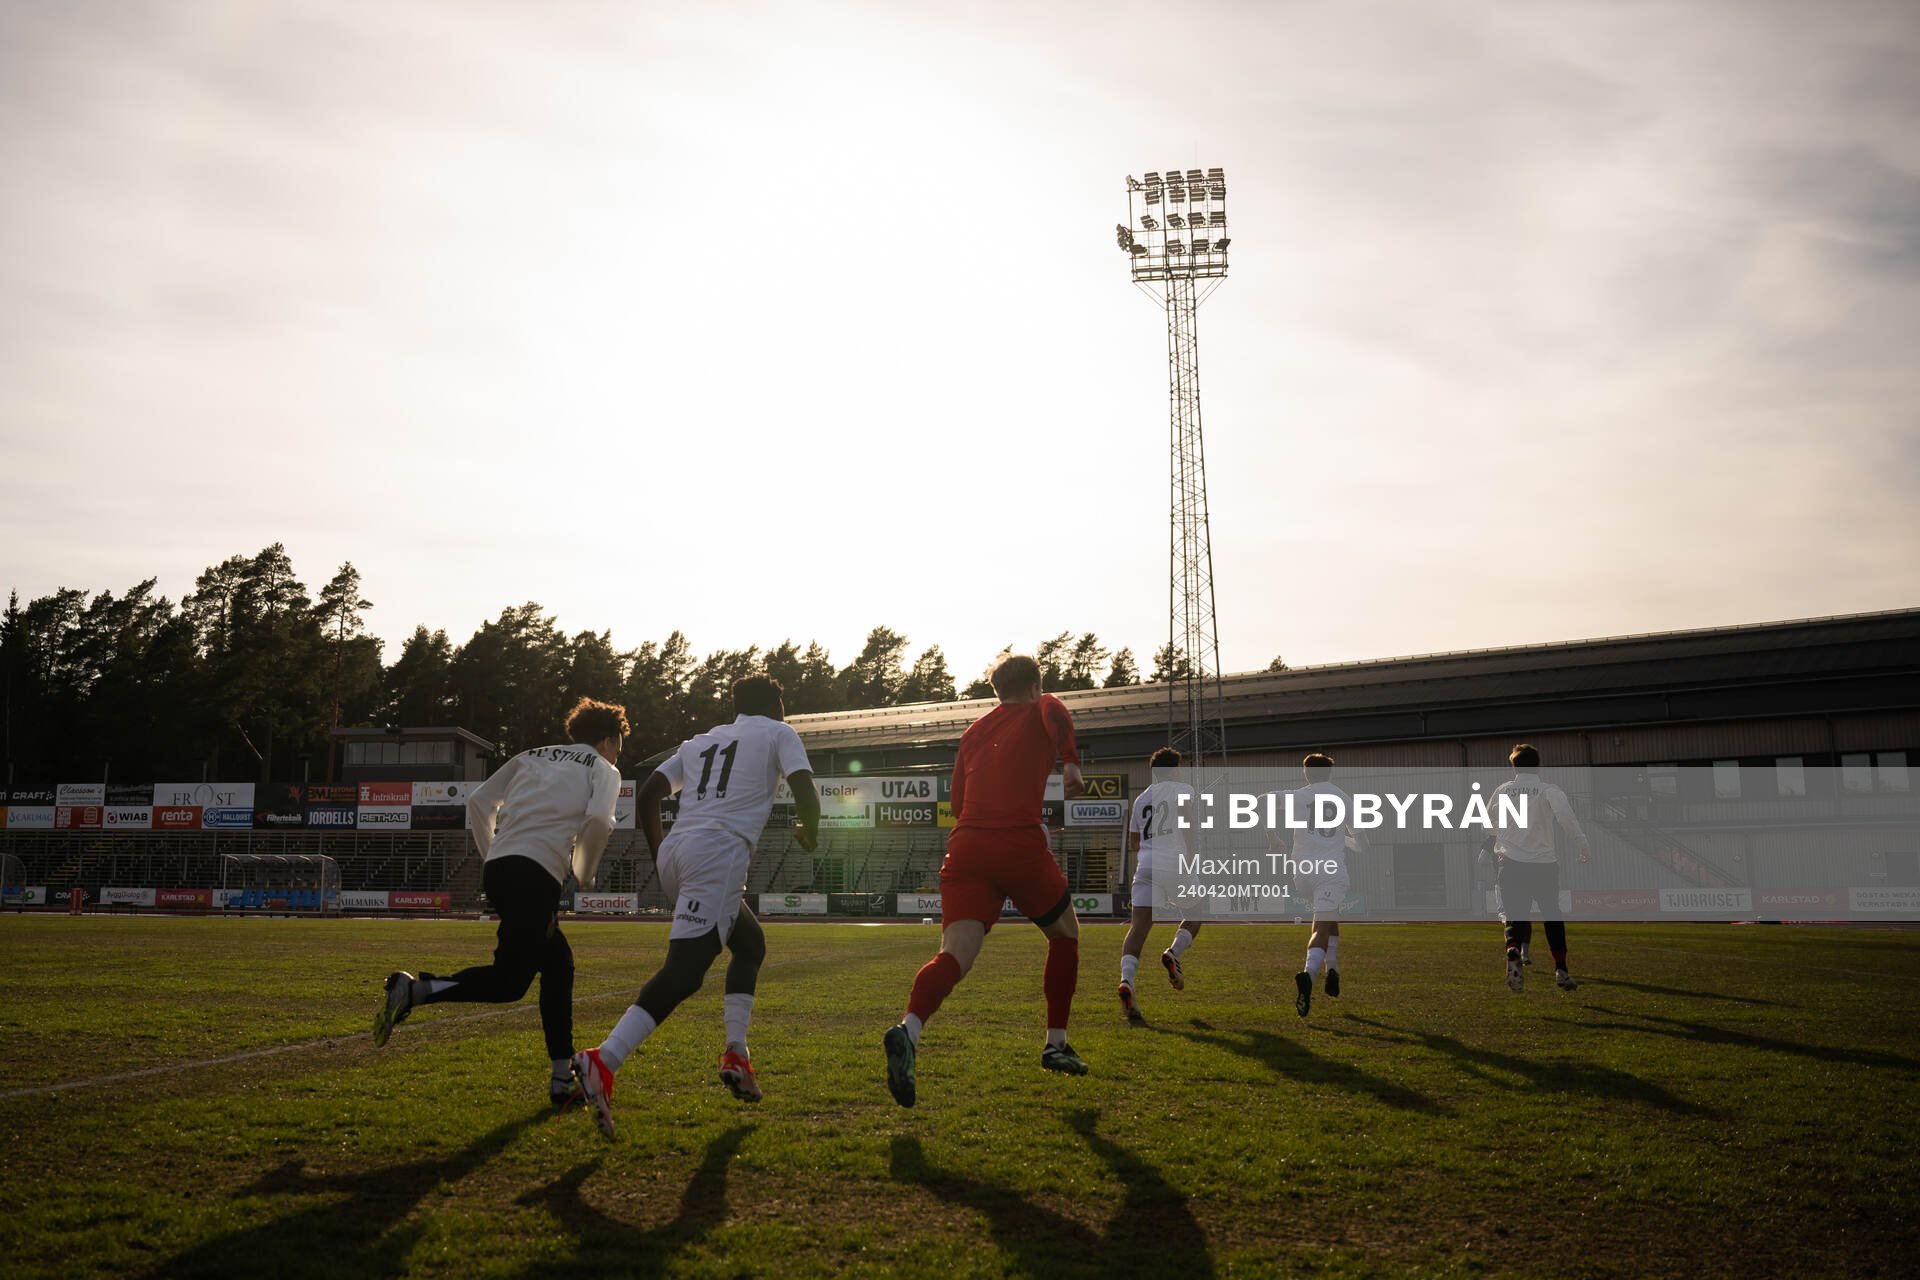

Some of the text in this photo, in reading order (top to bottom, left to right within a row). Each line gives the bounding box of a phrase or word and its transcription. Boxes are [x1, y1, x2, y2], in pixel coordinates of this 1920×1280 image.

[697, 740, 739, 800] 11
[882, 781, 930, 798] UTAB
[12, 792, 46, 800] CRAFT
[372, 793, 410, 801] Infrakraft
[119, 813, 148, 821] WIAB
[161, 810, 193, 821] renta
[360, 813, 409, 822] RETHAB
[880, 807, 932, 824] Hugos
[1077, 807, 1117, 817] WIPAB
[308, 811, 355, 825] JORDELLS
[1142, 801, 1173, 840] 22
[581, 896, 631, 908] Scandic
[1666, 894, 1744, 907] TJURRUSET
[1762, 896, 1819, 904] KARLSTAD
